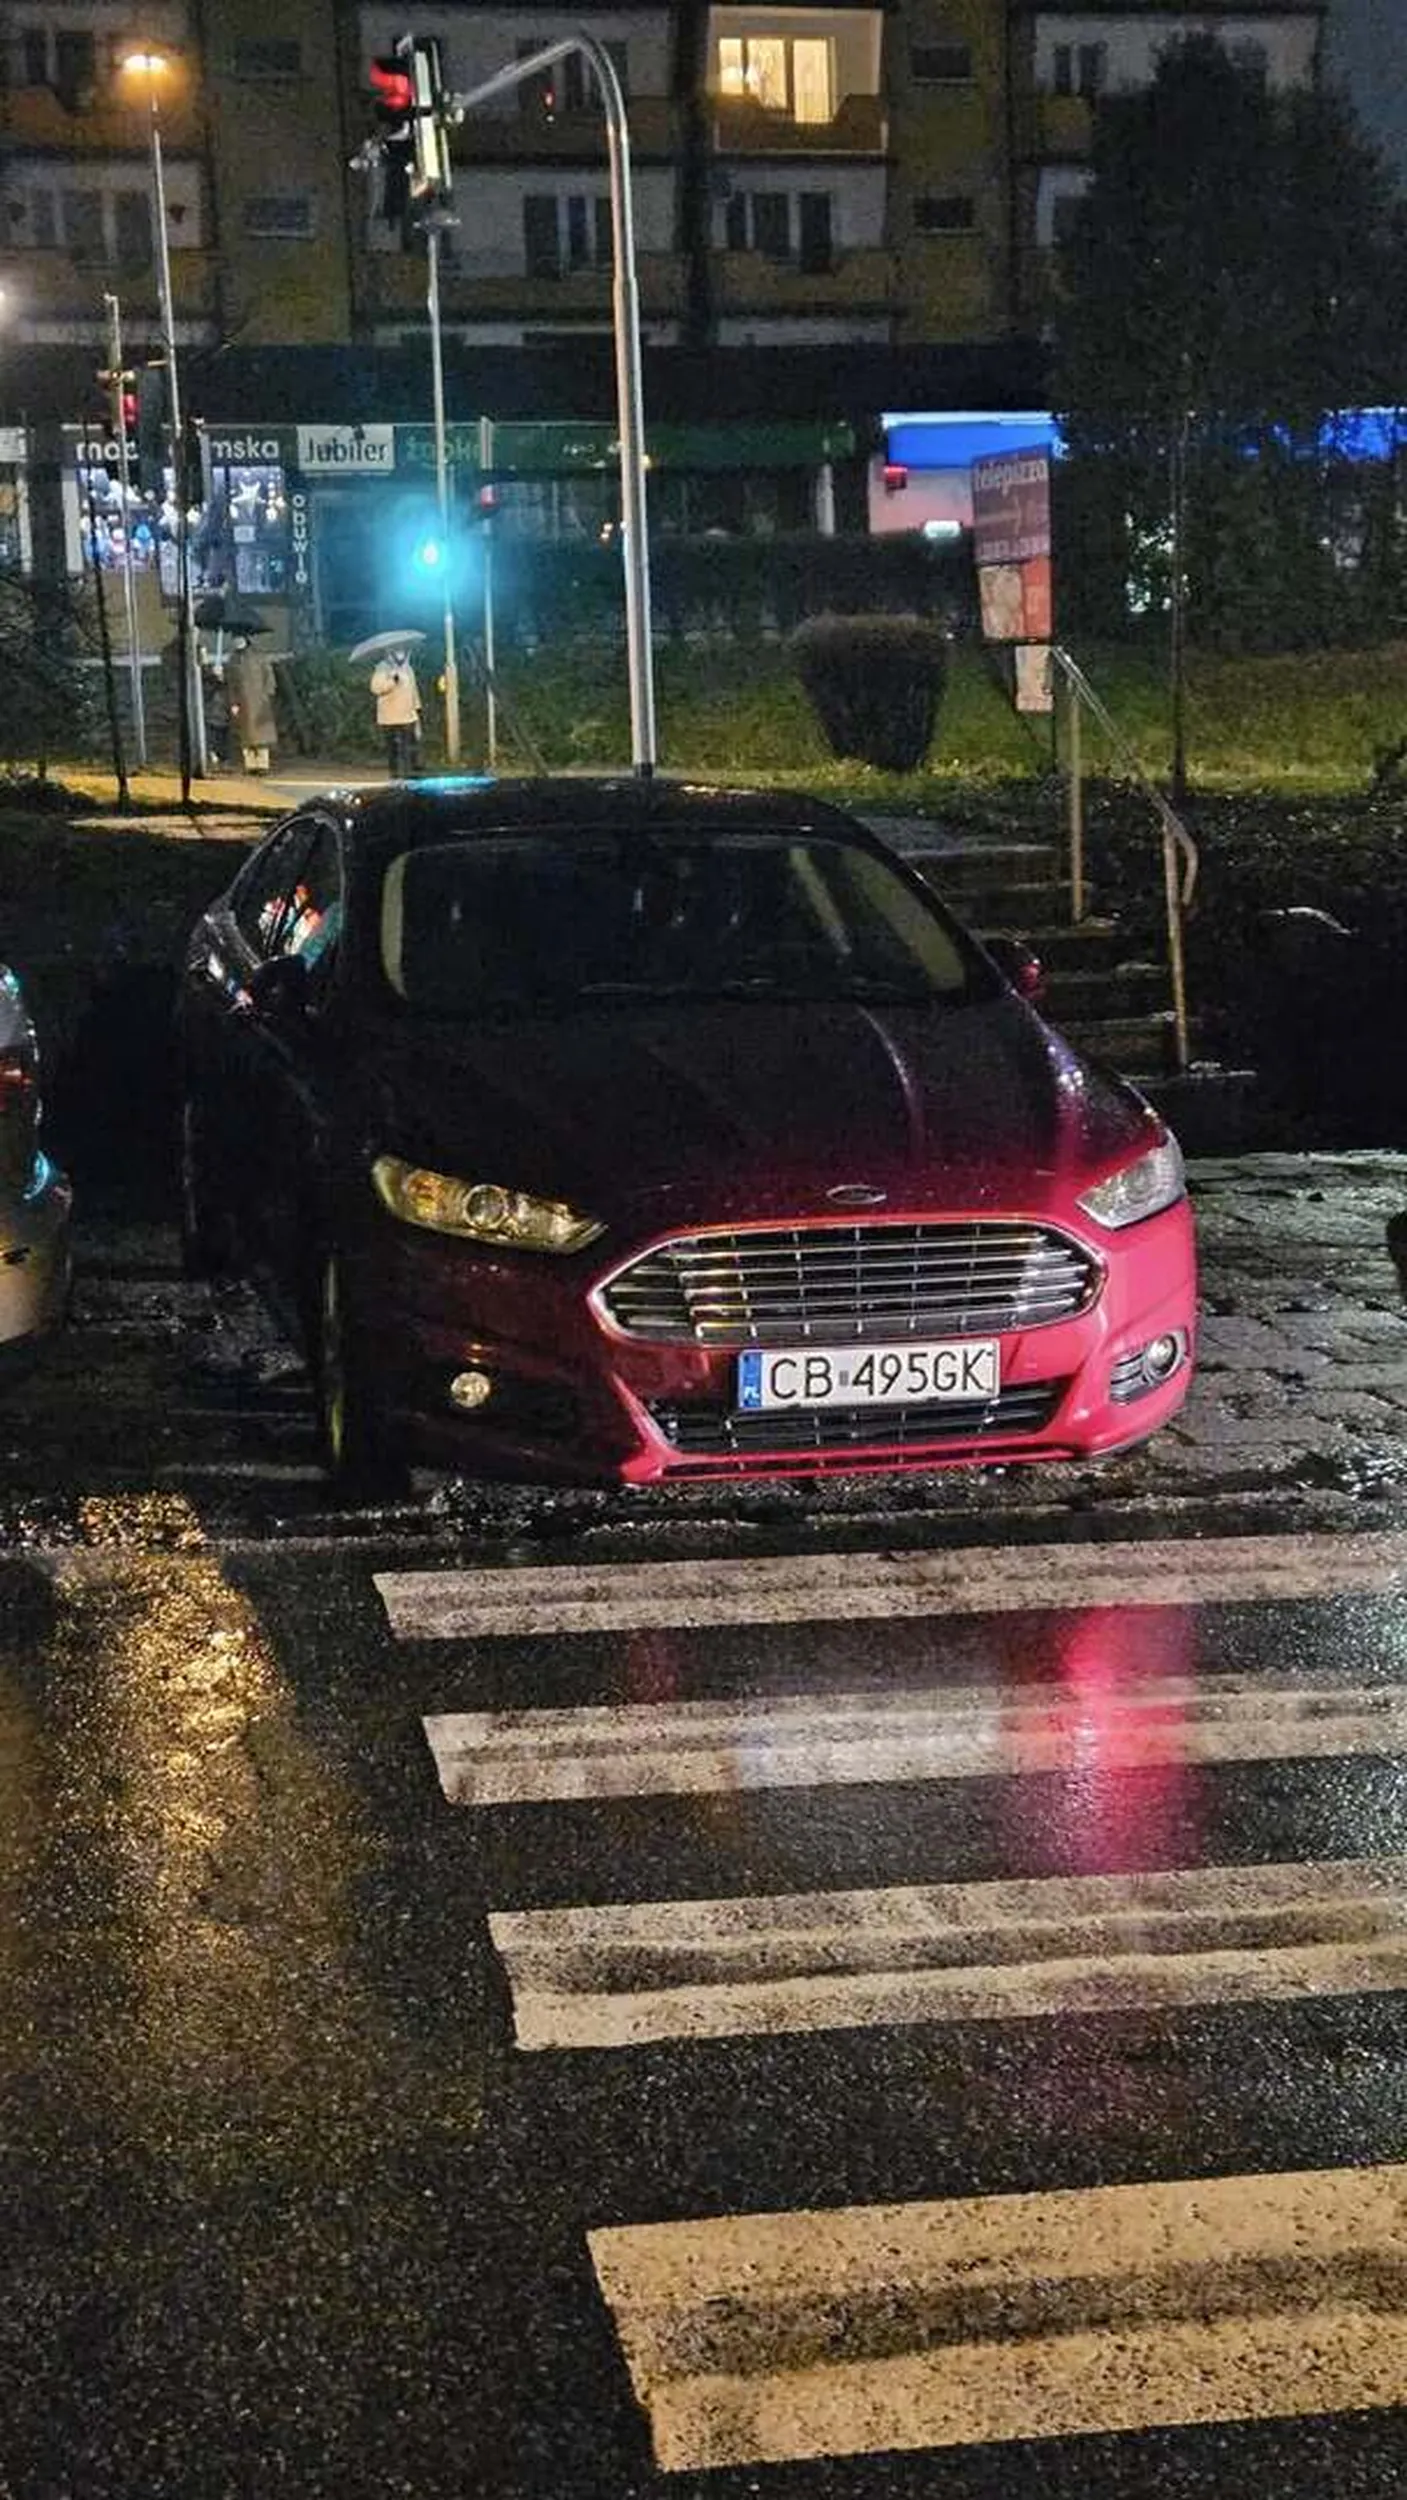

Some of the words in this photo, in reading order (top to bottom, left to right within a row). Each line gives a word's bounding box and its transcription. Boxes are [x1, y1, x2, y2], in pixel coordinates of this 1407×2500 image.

[304, 436, 389, 463] Jubiler
[770, 1356, 833, 1400] CB
[851, 1349, 988, 1397] 495GK
